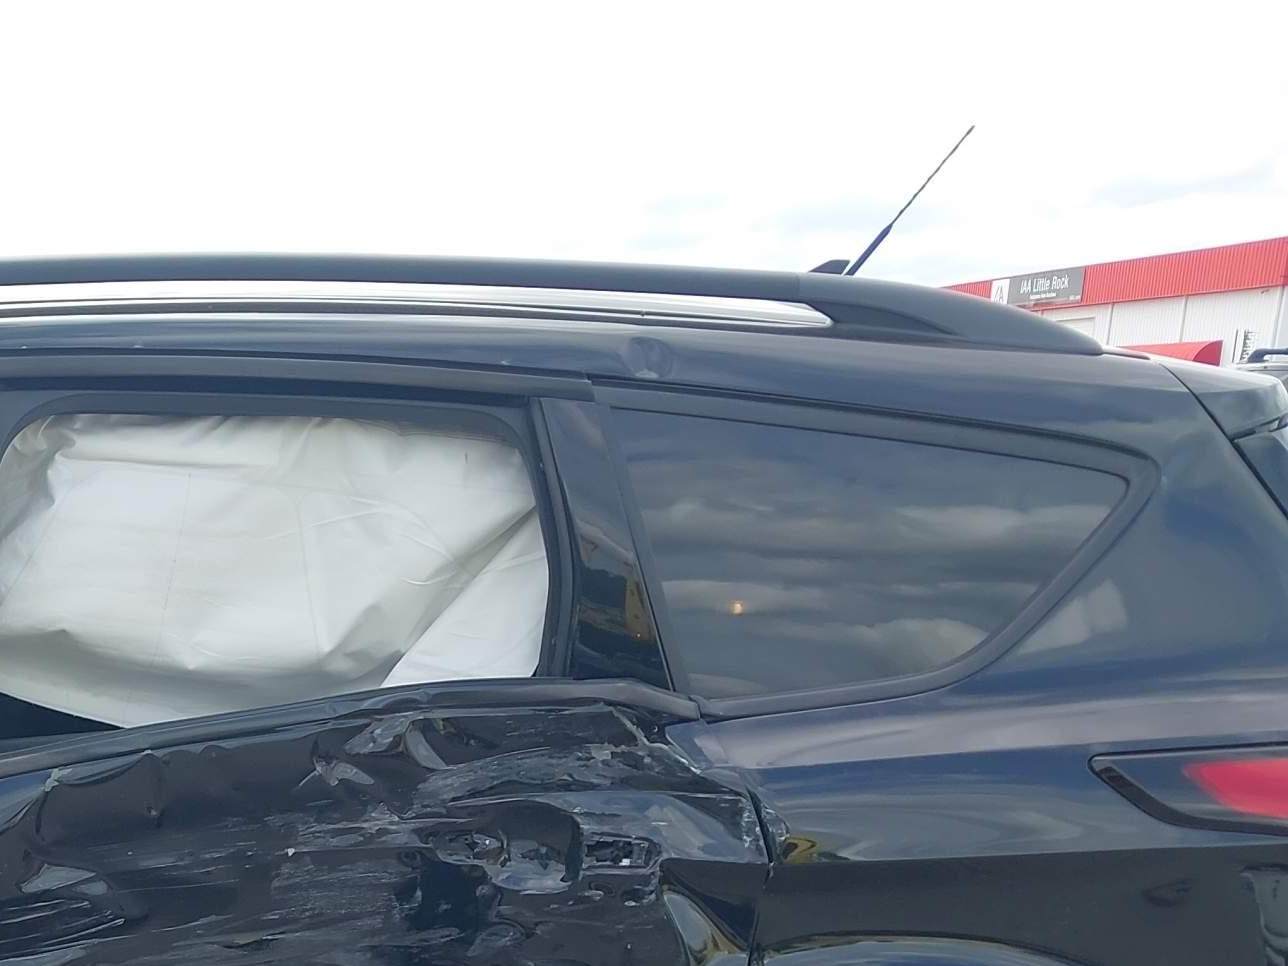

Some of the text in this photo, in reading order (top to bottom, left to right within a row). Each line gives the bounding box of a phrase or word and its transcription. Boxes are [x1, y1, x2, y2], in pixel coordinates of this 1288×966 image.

[1020, 279, 1032, 294] IAA
[1033, 277, 1050, 292] Little
[1051, 274, 1070, 290] Rock
